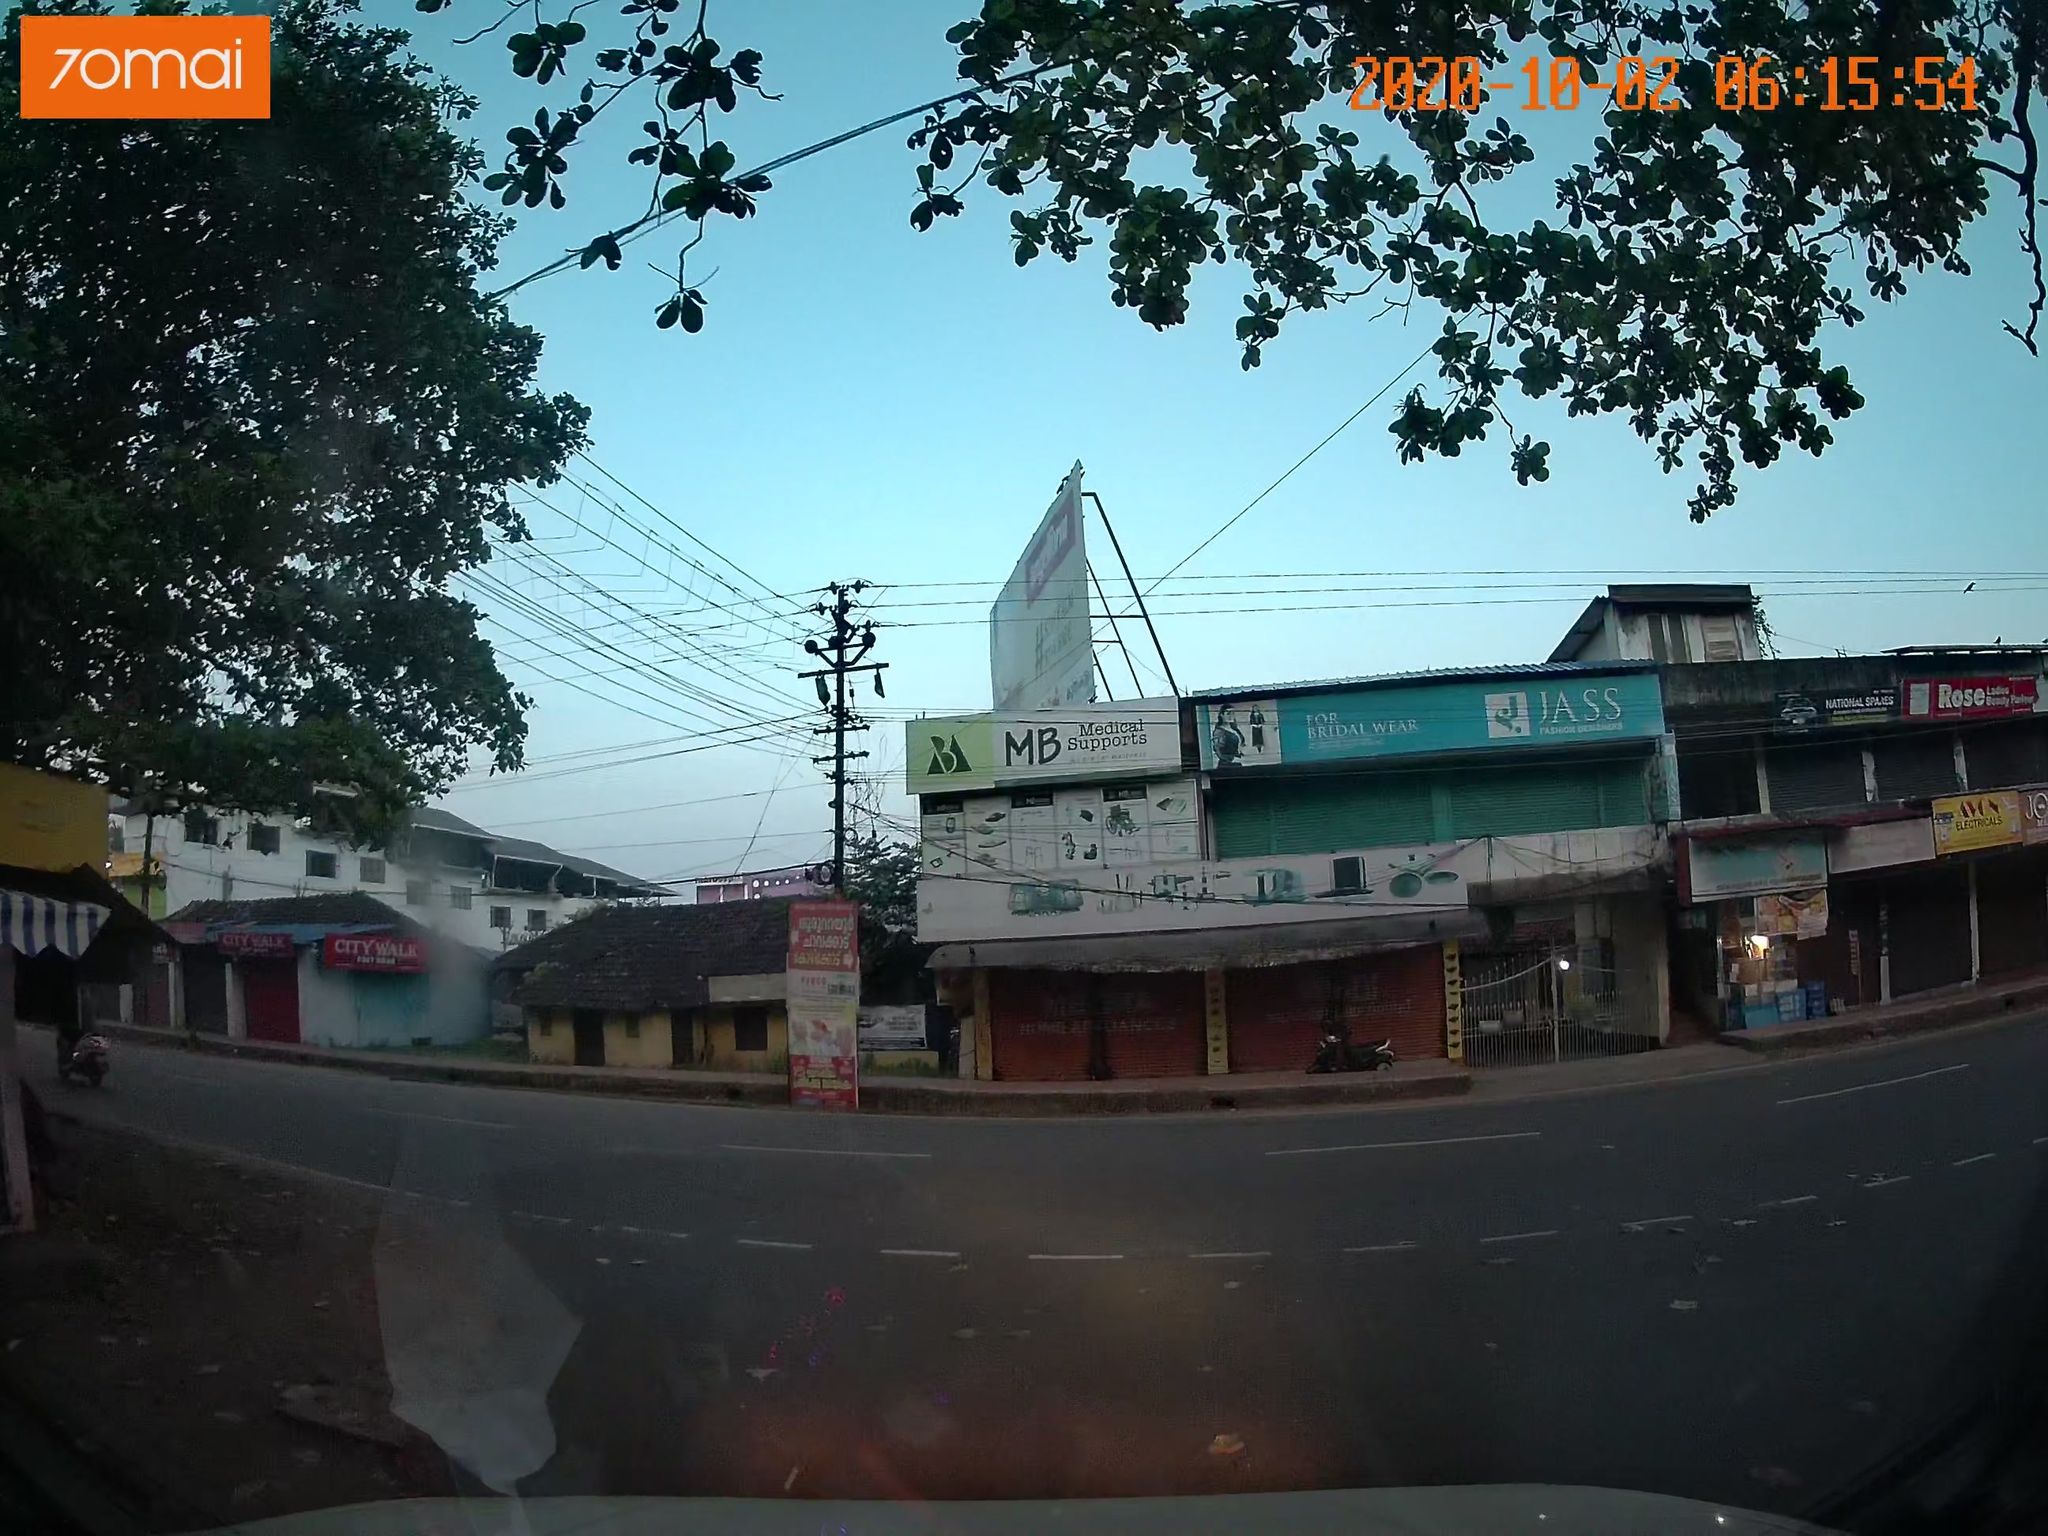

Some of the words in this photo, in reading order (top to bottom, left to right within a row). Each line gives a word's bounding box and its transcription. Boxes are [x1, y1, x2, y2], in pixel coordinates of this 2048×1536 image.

[1540, 687, 1621, 722] JASS
[1825, 698, 1865, 709] NATIONAL
[1938, 684, 1986, 708] Rose
[1079, 719, 1145, 737] Medical
[1306, 712, 1338, 726] FOR
[1308, 723, 1365, 738] BRIDAL
[1372, 719, 1418, 733] WEAR
[1005, 727, 1062, 766] MB
[1067, 733, 1148, 751] Supports
[1956, 816, 2003, 831] ELECTRICALS
[335, 939, 375, 954] CITY
[374, 940, 417, 957] WALK
